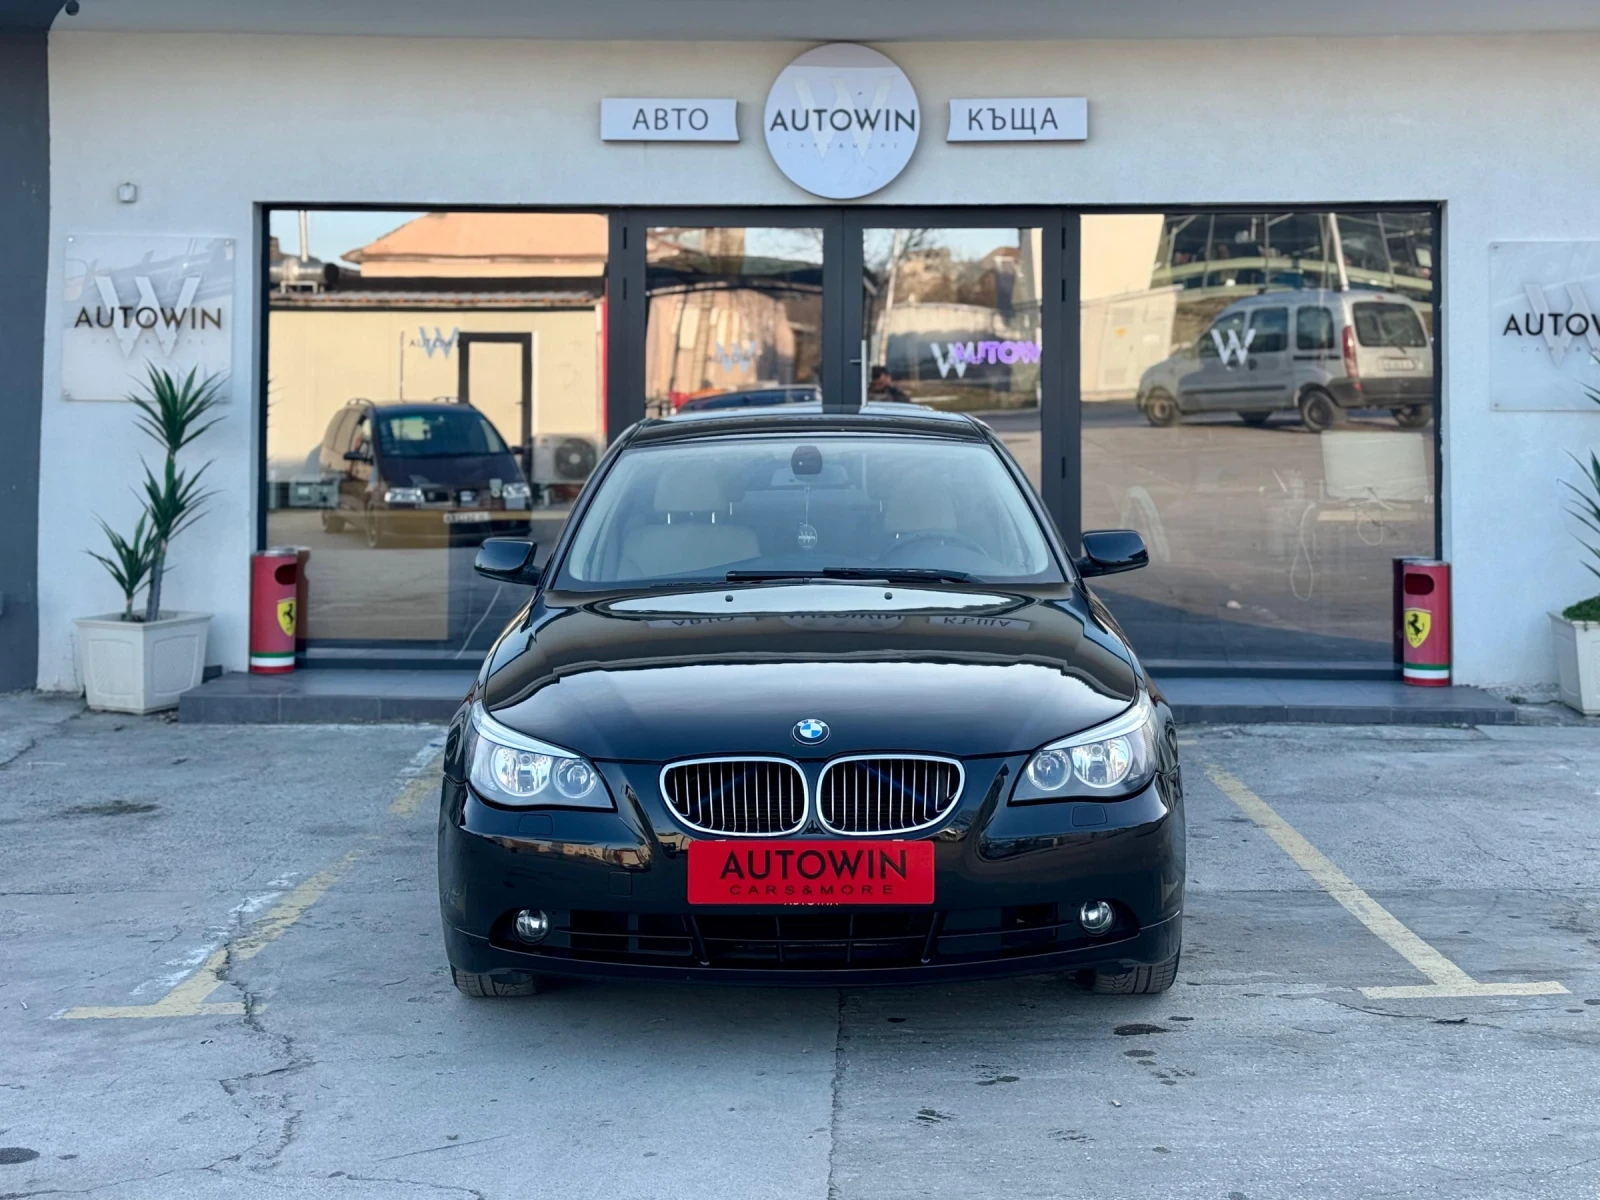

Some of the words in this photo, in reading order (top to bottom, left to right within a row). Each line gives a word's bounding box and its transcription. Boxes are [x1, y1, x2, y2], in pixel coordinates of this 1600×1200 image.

[632, 107, 710, 131] АВТО
[769, 108, 915, 132] AUTOWIN
[967, 107, 1059, 134] КЪЩА
[74, 306, 222, 330] AUTOWIN
[1210, 328, 1257, 365] W
[719, 849, 907, 881] AUTOWIN
[729, 884, 894, 896] CARS&MORE
